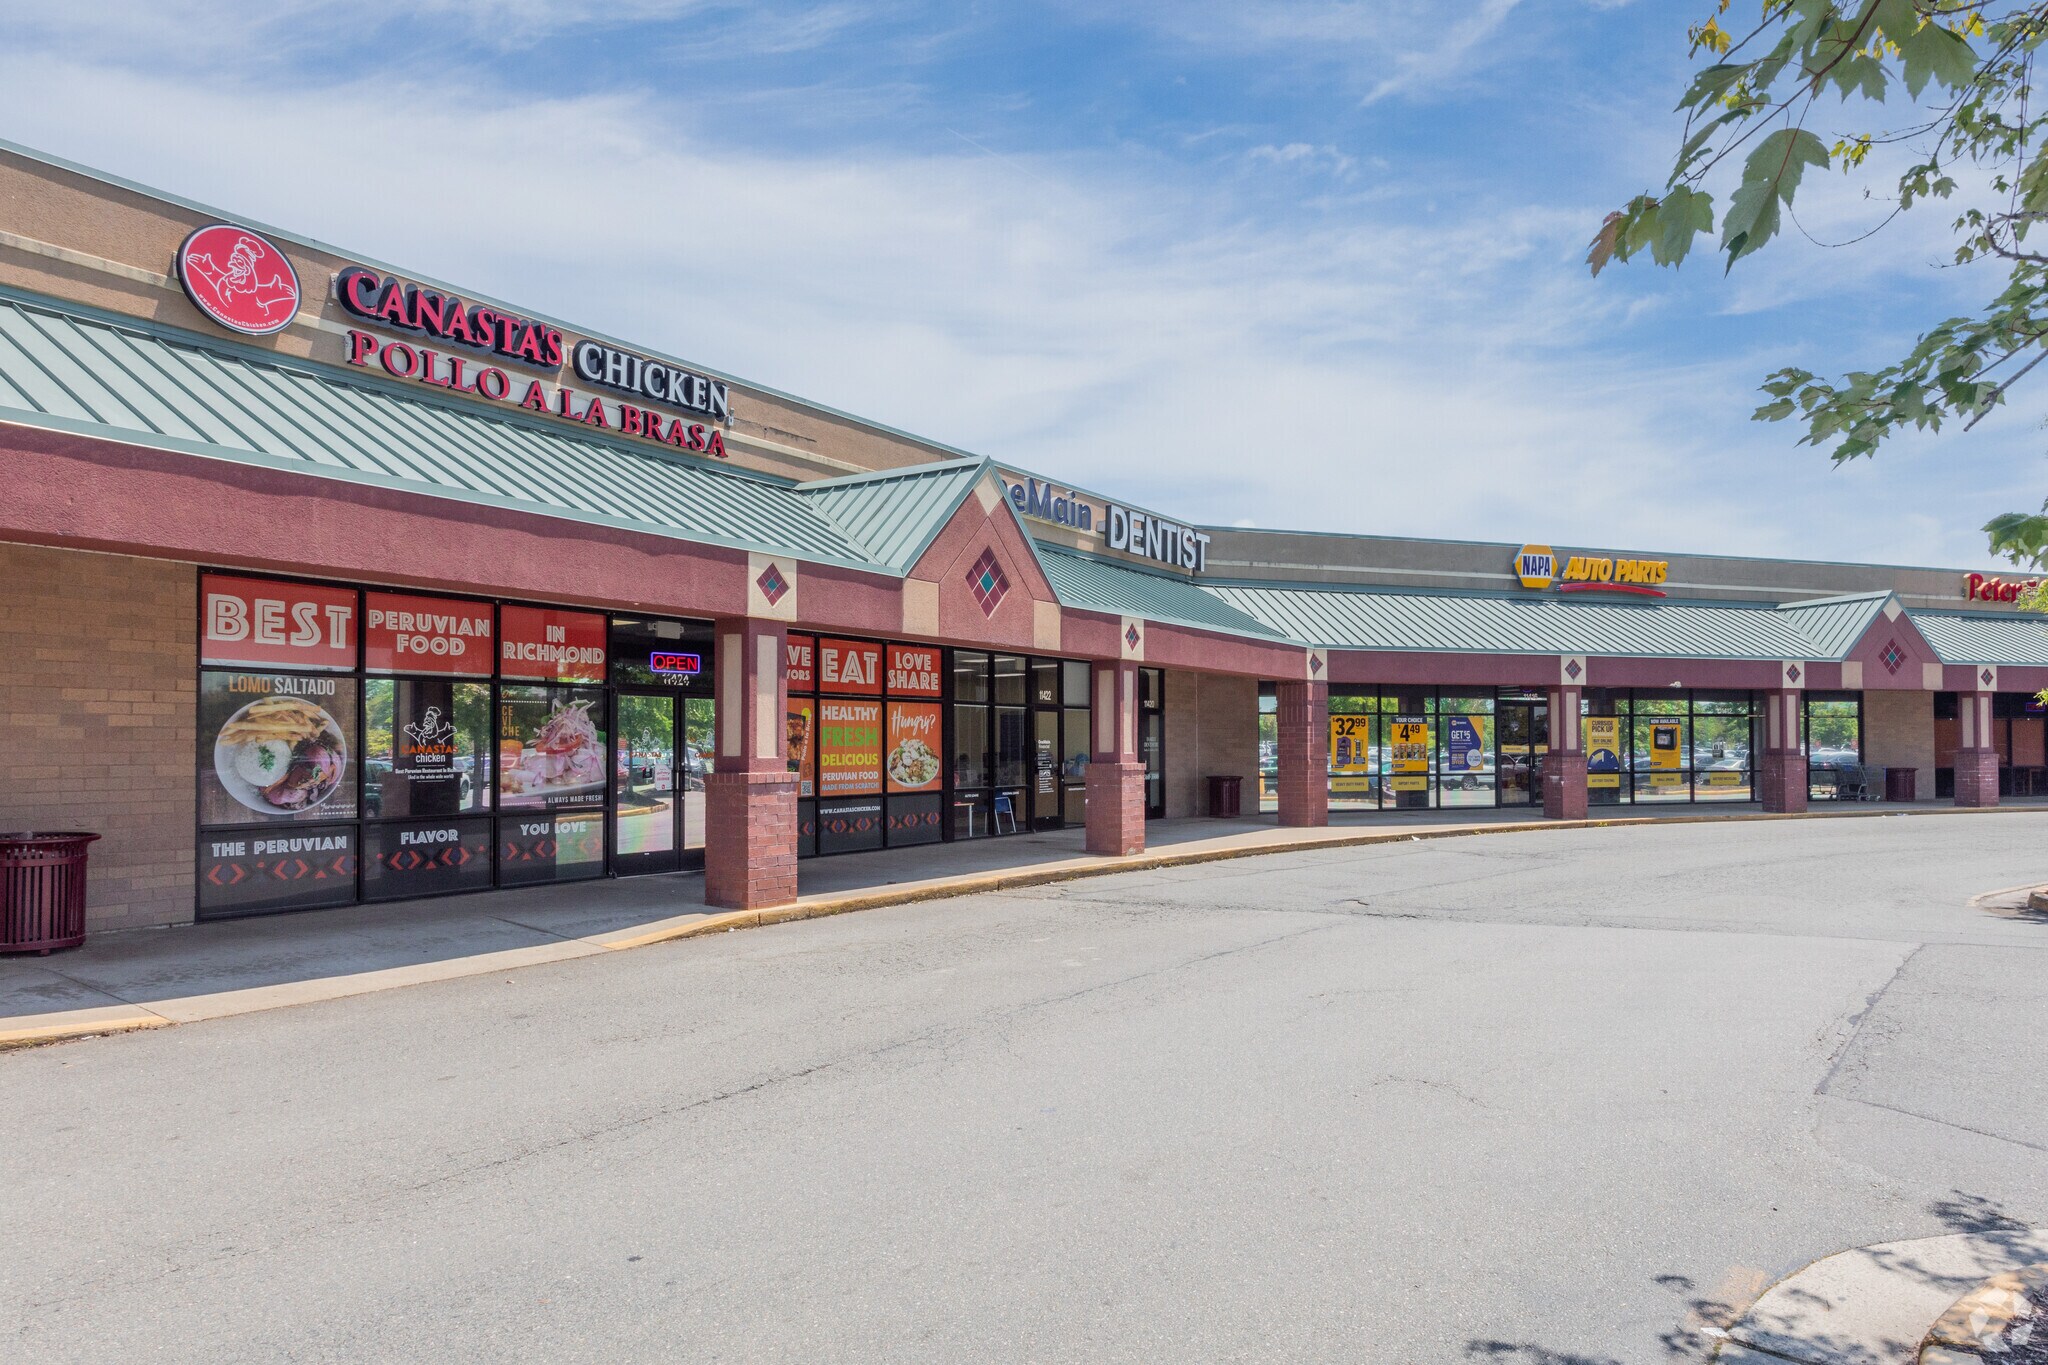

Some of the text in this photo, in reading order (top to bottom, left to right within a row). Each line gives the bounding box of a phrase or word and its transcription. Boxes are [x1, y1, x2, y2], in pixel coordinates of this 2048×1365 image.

[343, 270, 563, 368] CANASTA'S
[576, 342, 730, 419] CHICKEN
[347, 329, 729, 458] POLLO A LA BRASA
[1002, 477, 1211, 573] eMain DENTIST
[1522, 555, 1669, 585] NAPA AUTO PARTS
[1964, 573, 2023, 604] Peter
[207, 593, 352, 649] BEST
[368, 609, 490, 638] PERUVIAN
[396, 633, 466, 656] FOOD
[546, 625, 565, 643] IN
[503, 641, 605, 664] RICHMOND
[653, 655, 698, 671] OPEN
[787, 645, 811, 667] VE
[895, 651, 932, 671] LOVE
[821, 648, 878, 685] EAT
[229, 676, 335, 695] LOMO SALTADO
[888, 669, 939, 691] SHARE
[1039, 690, 1052, 700] 11422
[821, 705, 878, 721] HEALTHY
[891, 705, 936, 737] Hungry?
[502, 726, 519, 737] CHE
[821, 726, 878, 747] FRESH
[1451, 730, 1471, 740] GET $5
[415, 752, 446, 763] chicken
[822, 771, 879, 781] PERUVIAN FOOD
[547, 796, 569, 804] ALWAYS
[585, 794, 604, 802] FRESH!
[400, 828, 459, 845] FLAVOR
[520, 821, 587, 836] YOU LOVE
[211, 836, 347, 858] THE PERUVIAN
